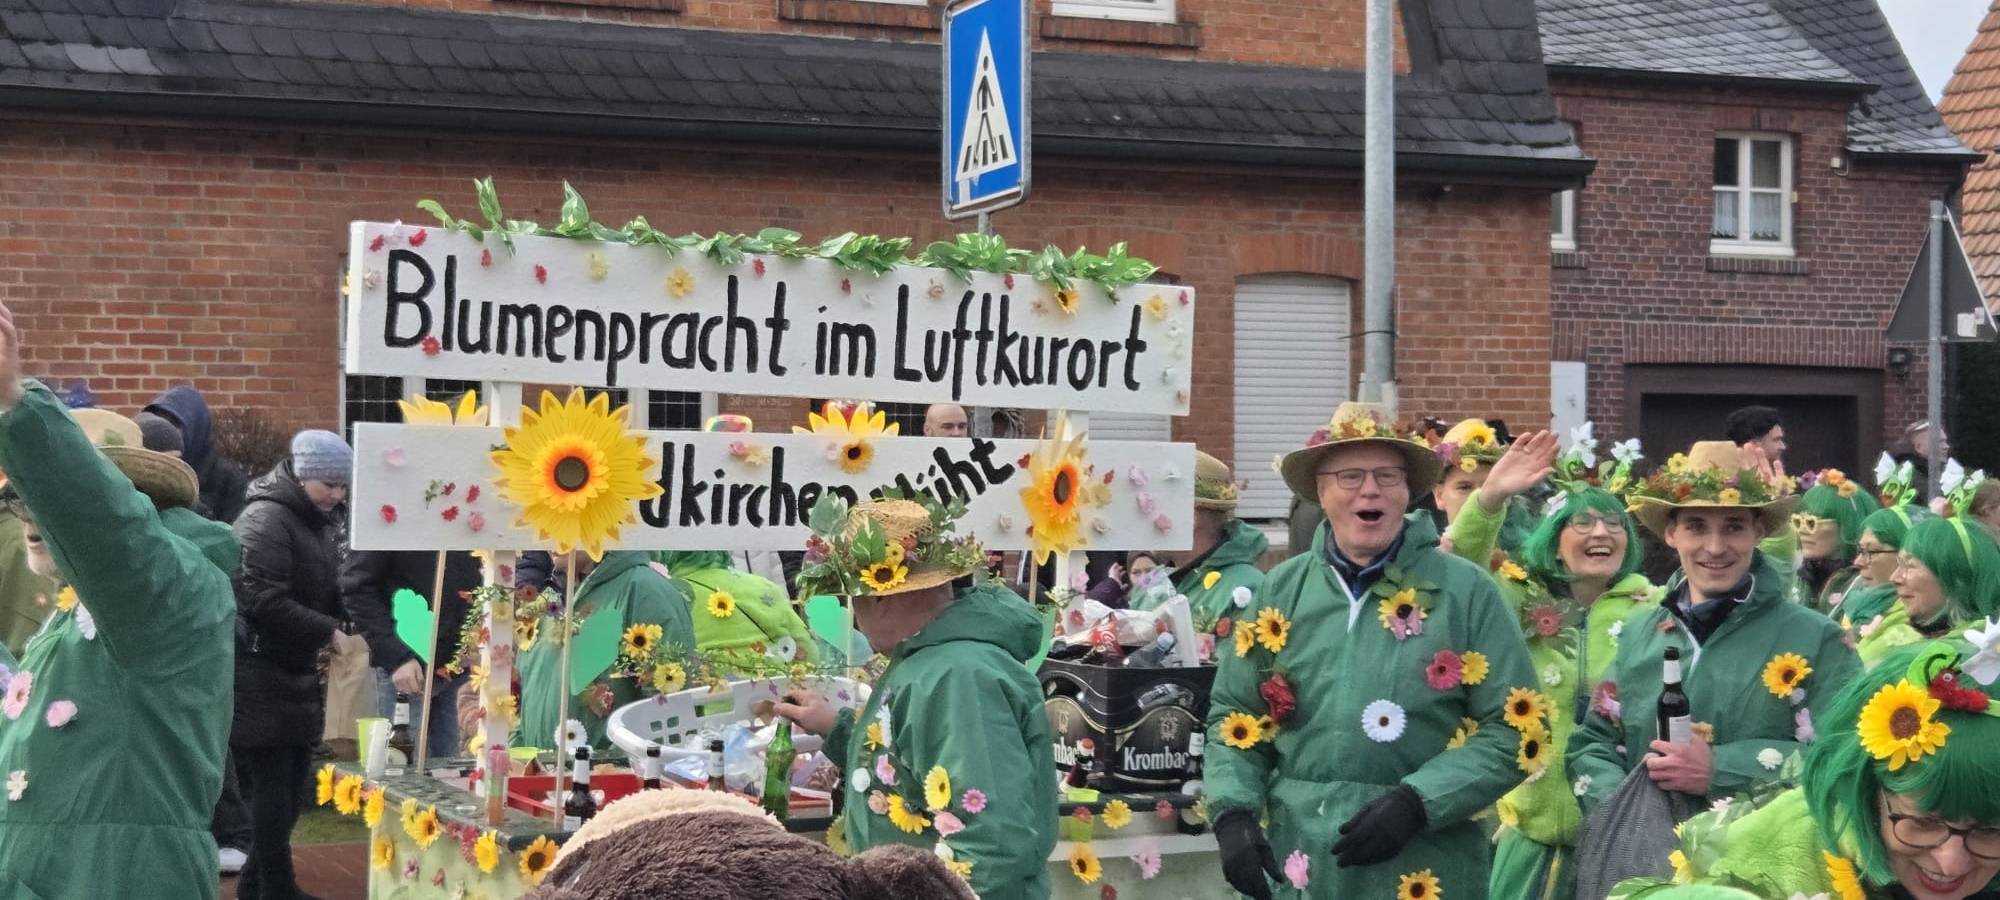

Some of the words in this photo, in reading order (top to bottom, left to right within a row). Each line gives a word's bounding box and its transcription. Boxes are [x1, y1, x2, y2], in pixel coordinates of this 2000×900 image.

[384, 249, 790, 386] Blumenpracht
[814, 304, 876, 378] im
[894, 283, 1147, 401] Luftkurort
[1123, 745, 1190, 771] Krombac
